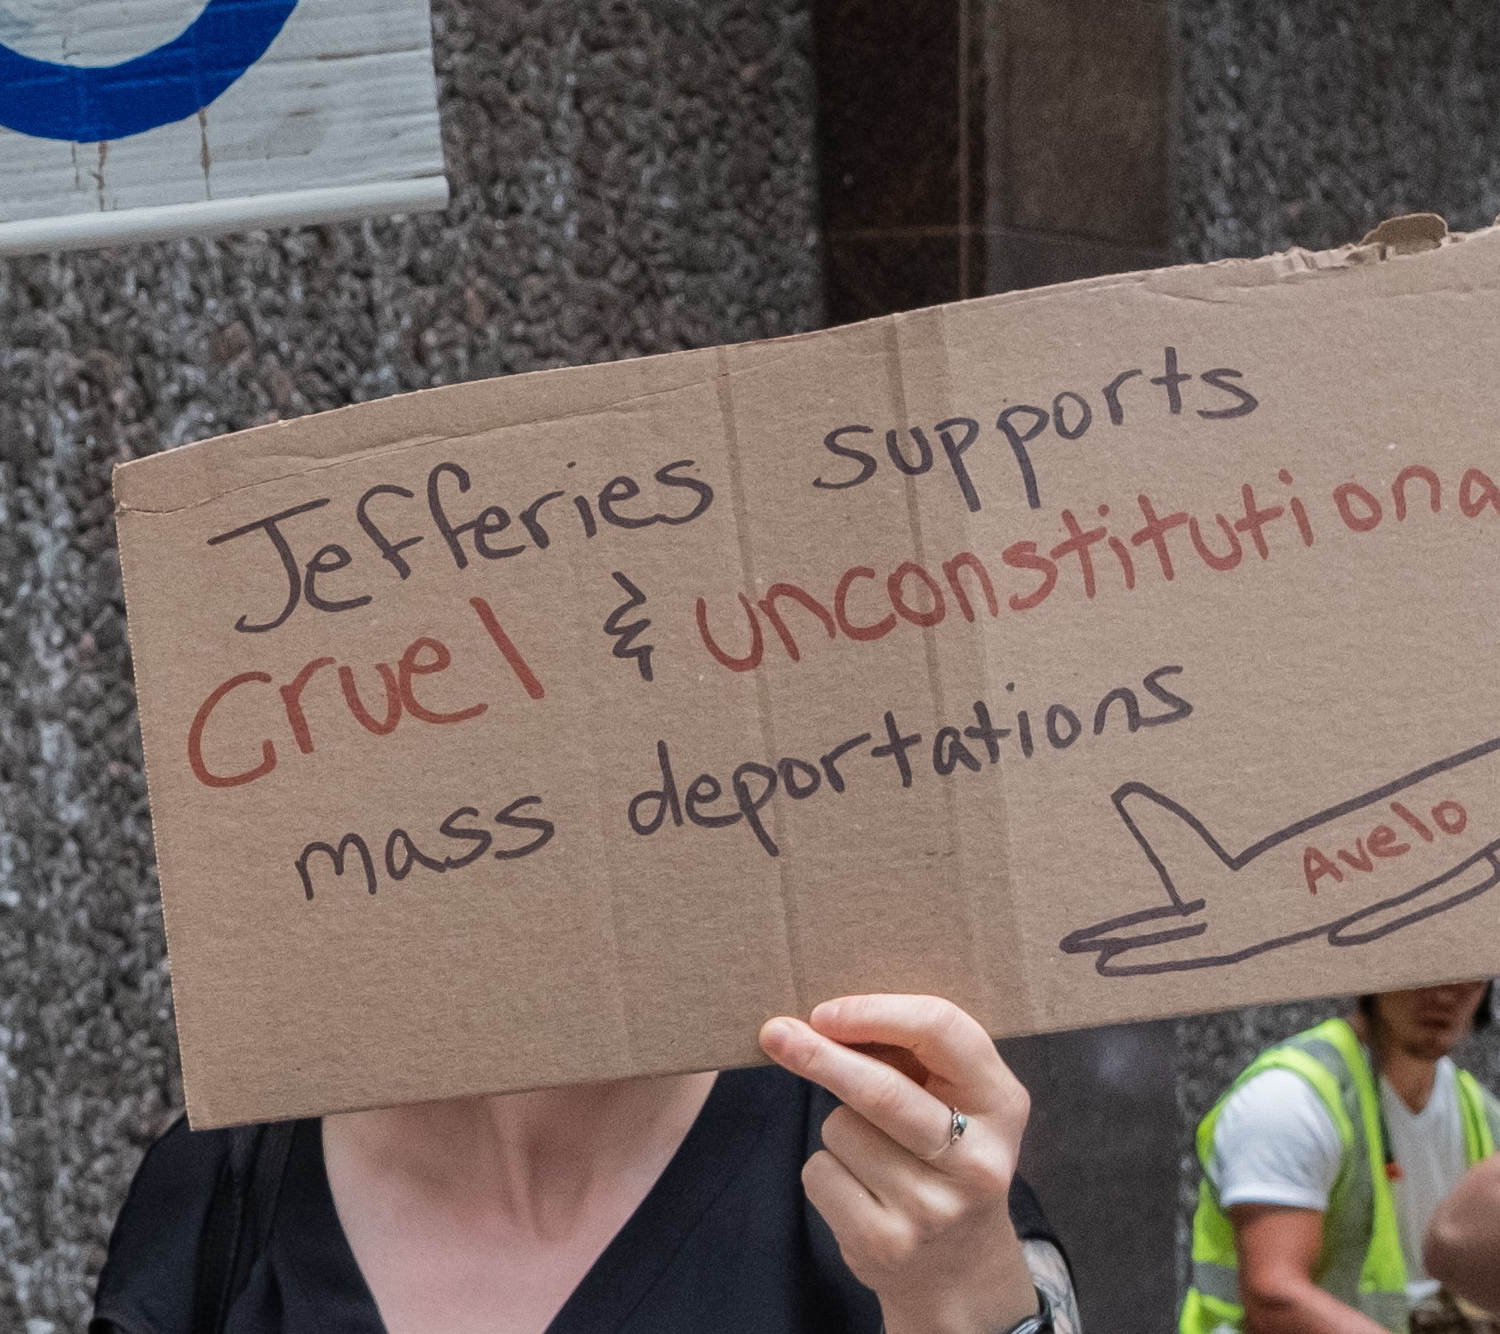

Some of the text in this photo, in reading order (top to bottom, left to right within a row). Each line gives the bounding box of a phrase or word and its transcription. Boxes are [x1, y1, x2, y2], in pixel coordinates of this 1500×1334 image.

[208, 346, 1257, 635] Jefferies supports
[603, 571, 655, 679] &
[292, 664, 1193, 902] mass deportations
[1301, 798, 1468, 893] Avelo
